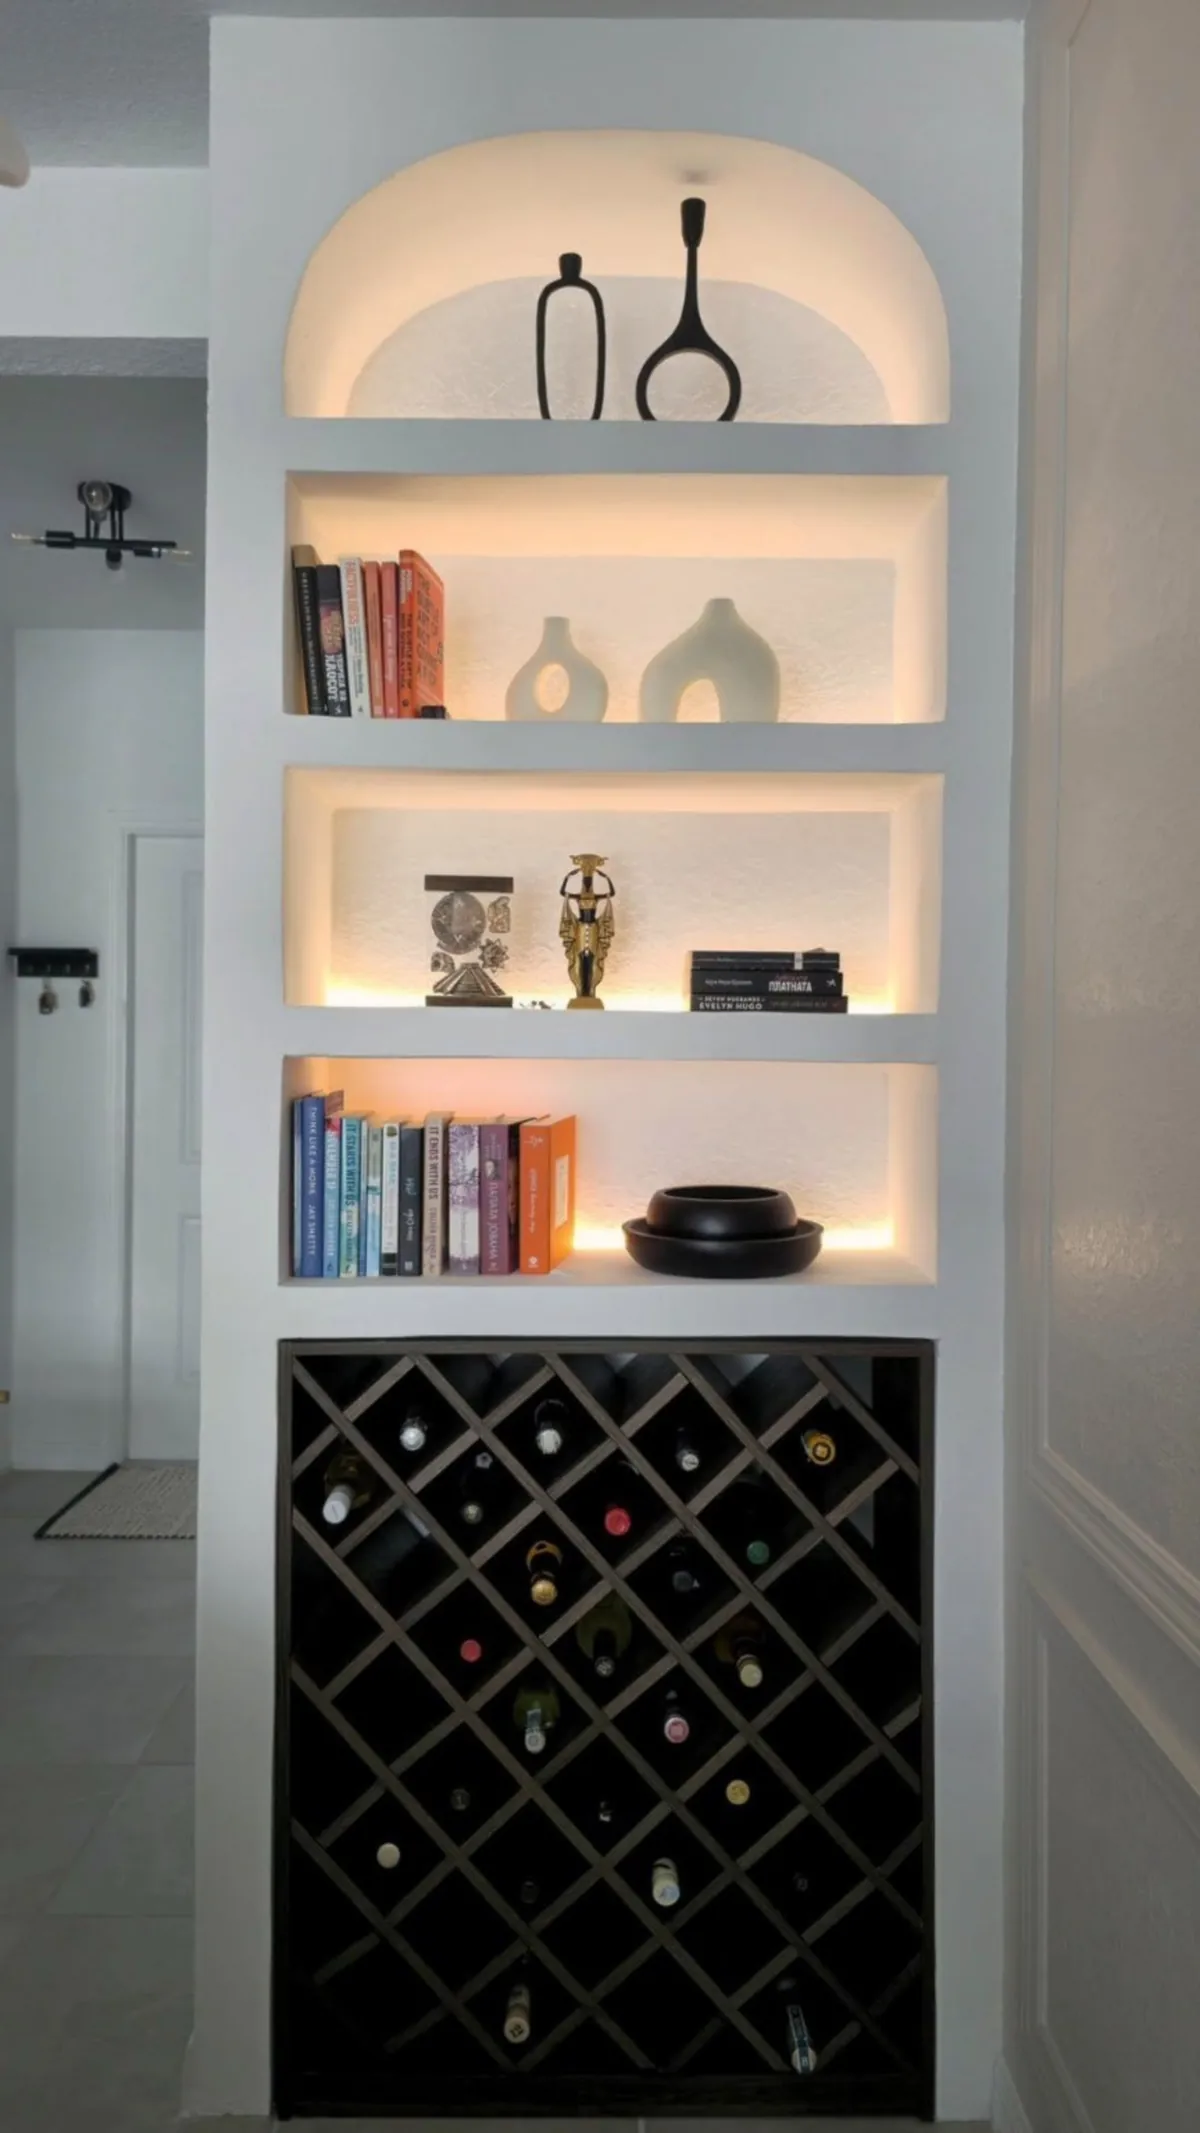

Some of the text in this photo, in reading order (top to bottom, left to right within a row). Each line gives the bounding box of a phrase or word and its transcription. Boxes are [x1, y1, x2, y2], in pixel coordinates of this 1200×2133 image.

[699, 1002, 733, 1010] EVELYN
[735, 1002, 763, 1010] HUGO
[346, 1123, 357, 1132] IT
[428, 1125, 439, 1134] IT
[346, 1135, 357, 1167] STARTS
[428, 1137, 439, 1160] ENDS
[307, 1106, 318, 1256] THINK LIKE A MONK JAY SHETTY
[346, 1169, 357, 1192] WITH
[428, 1163, 439, 1185] WITH
[345, 1194, 356, 1206] US
[428, 1187, 438, 1200] US
